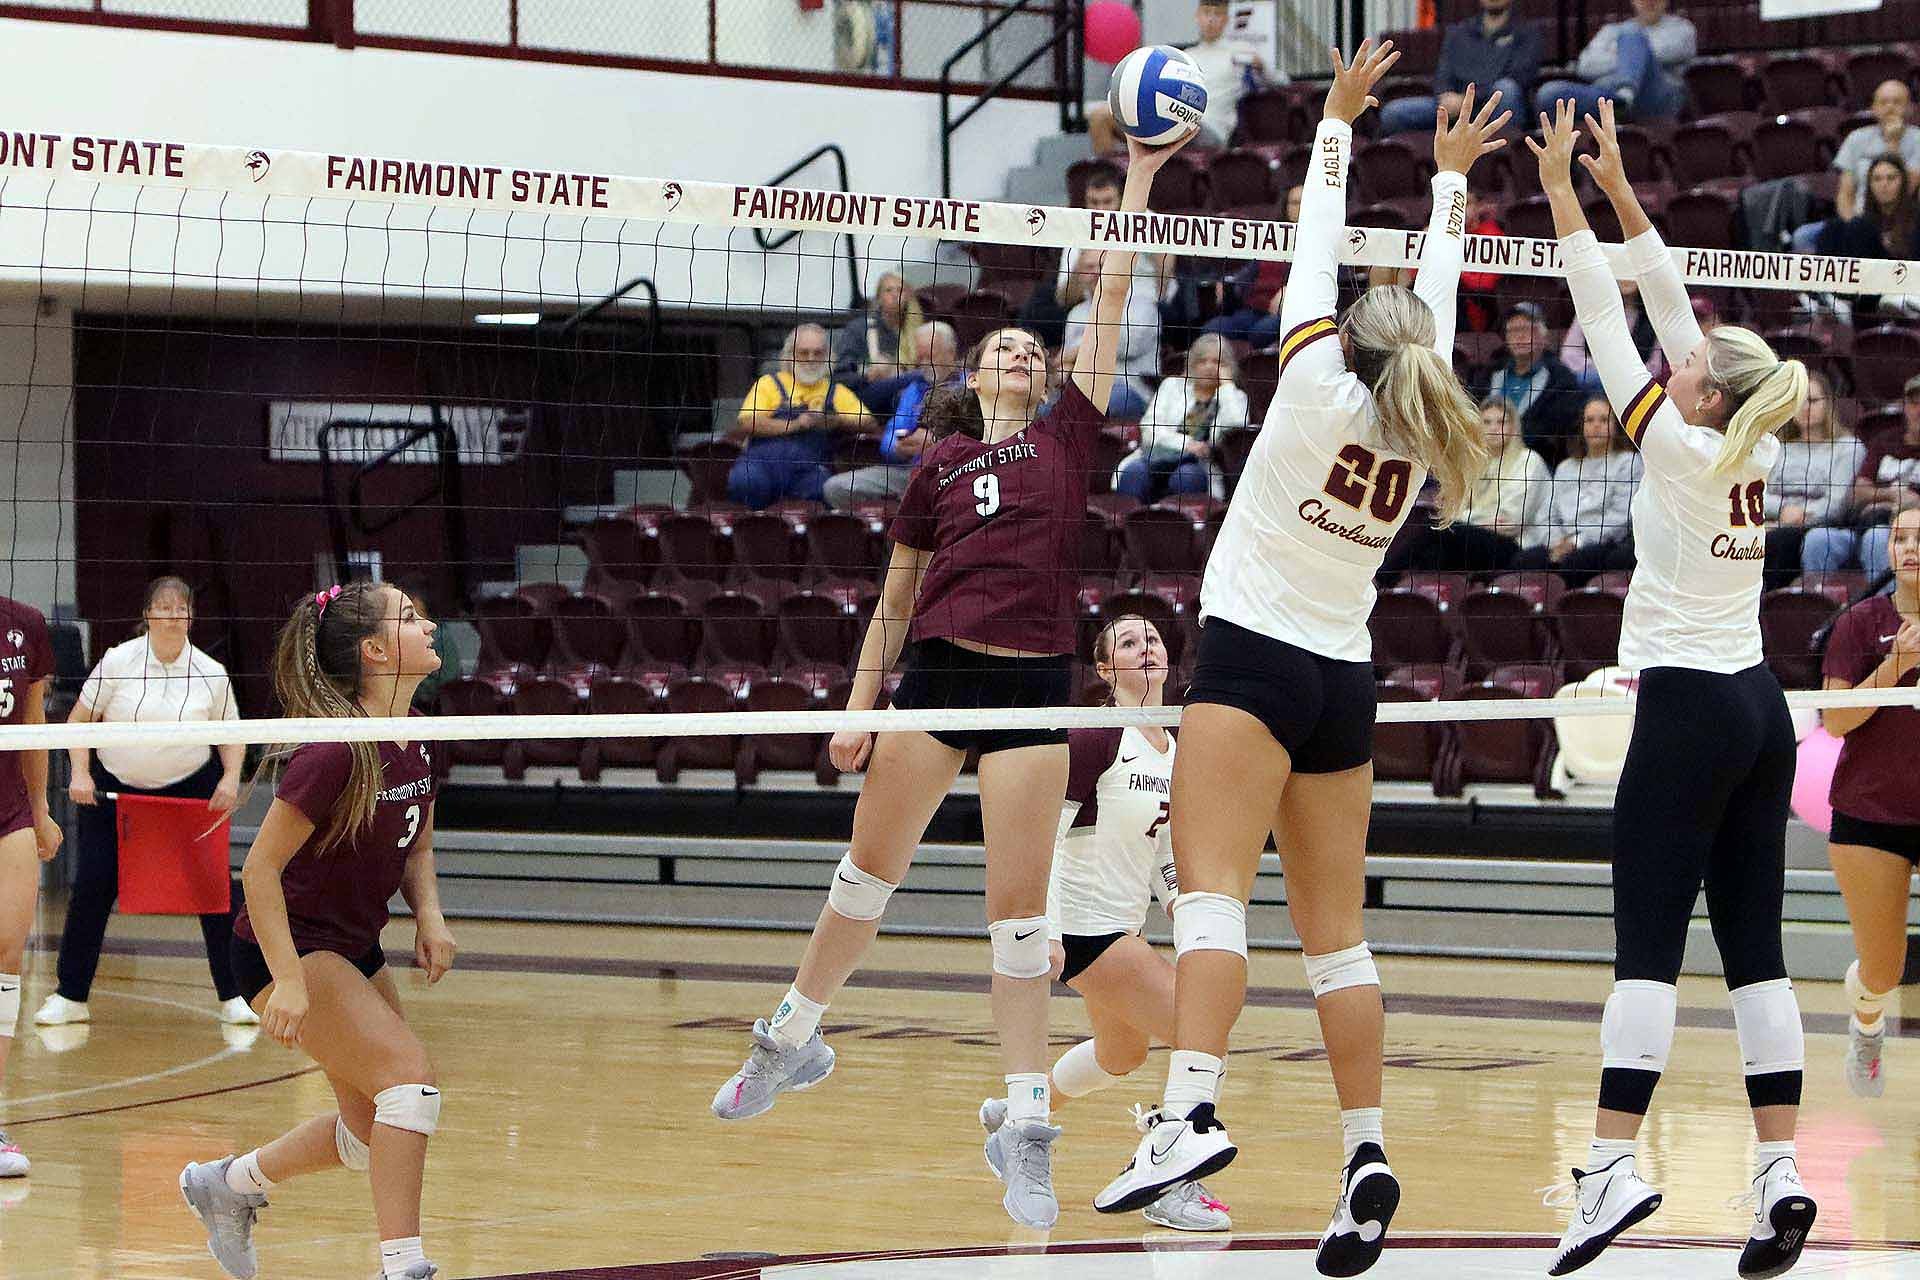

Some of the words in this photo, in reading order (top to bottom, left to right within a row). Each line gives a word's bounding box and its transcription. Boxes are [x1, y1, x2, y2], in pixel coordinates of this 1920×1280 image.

[72, 136, 185, 177] STATE
[1323, 136, 1341, 188] EAGLES
[327, 155, 502, 199] FAIRMONT
[511, 170, 610, 208] STATE
[733, 186, 886, 226] FAIRMONT
[892, 197, 980, 233] STATE
[1090, 211, 1225, 247] FAIRMONT
[1231, 221, 1298, 251] STAT
[1445, 190, 1465, 240] GOLDEN
[1405, 232, 1525, 266] FMONT
[1531, 241, 1564, 268] ST
[1686, 251, 1793, 281] FAIRMONT
[1799, 257, 1861, 284] STATE
[997, 443, 1038, 464] STATE
[973, 473, 1000, 517] 9
[1322, 444, 1412, 525] 20
[1728, 479, 1765, 527] 10
[1, 655, 26, 673] STATE
[397, 804, 421, 848] 3
